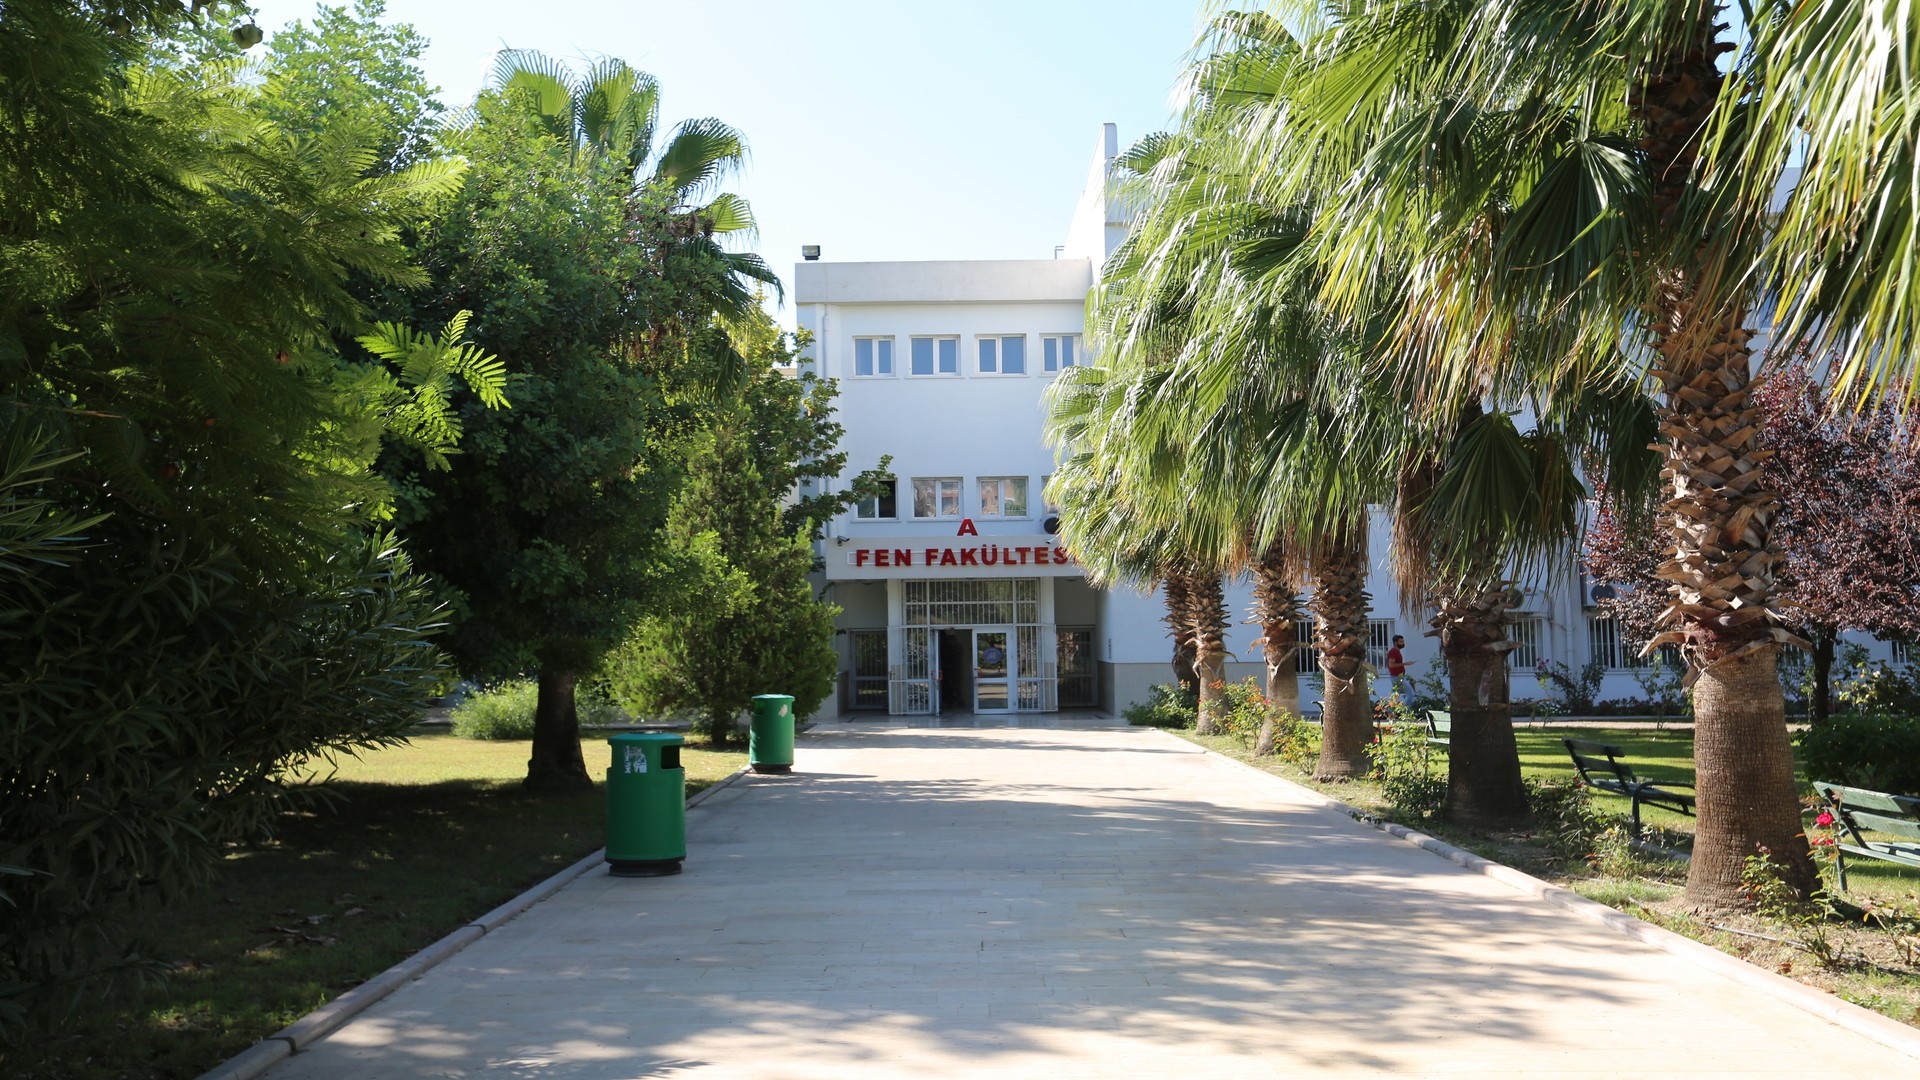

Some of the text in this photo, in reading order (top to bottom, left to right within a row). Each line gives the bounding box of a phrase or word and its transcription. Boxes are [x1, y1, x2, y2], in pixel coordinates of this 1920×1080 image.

[957, 518, 978, 536] A
[856, 544, 1079, 567] FEN FAKÜLTES
